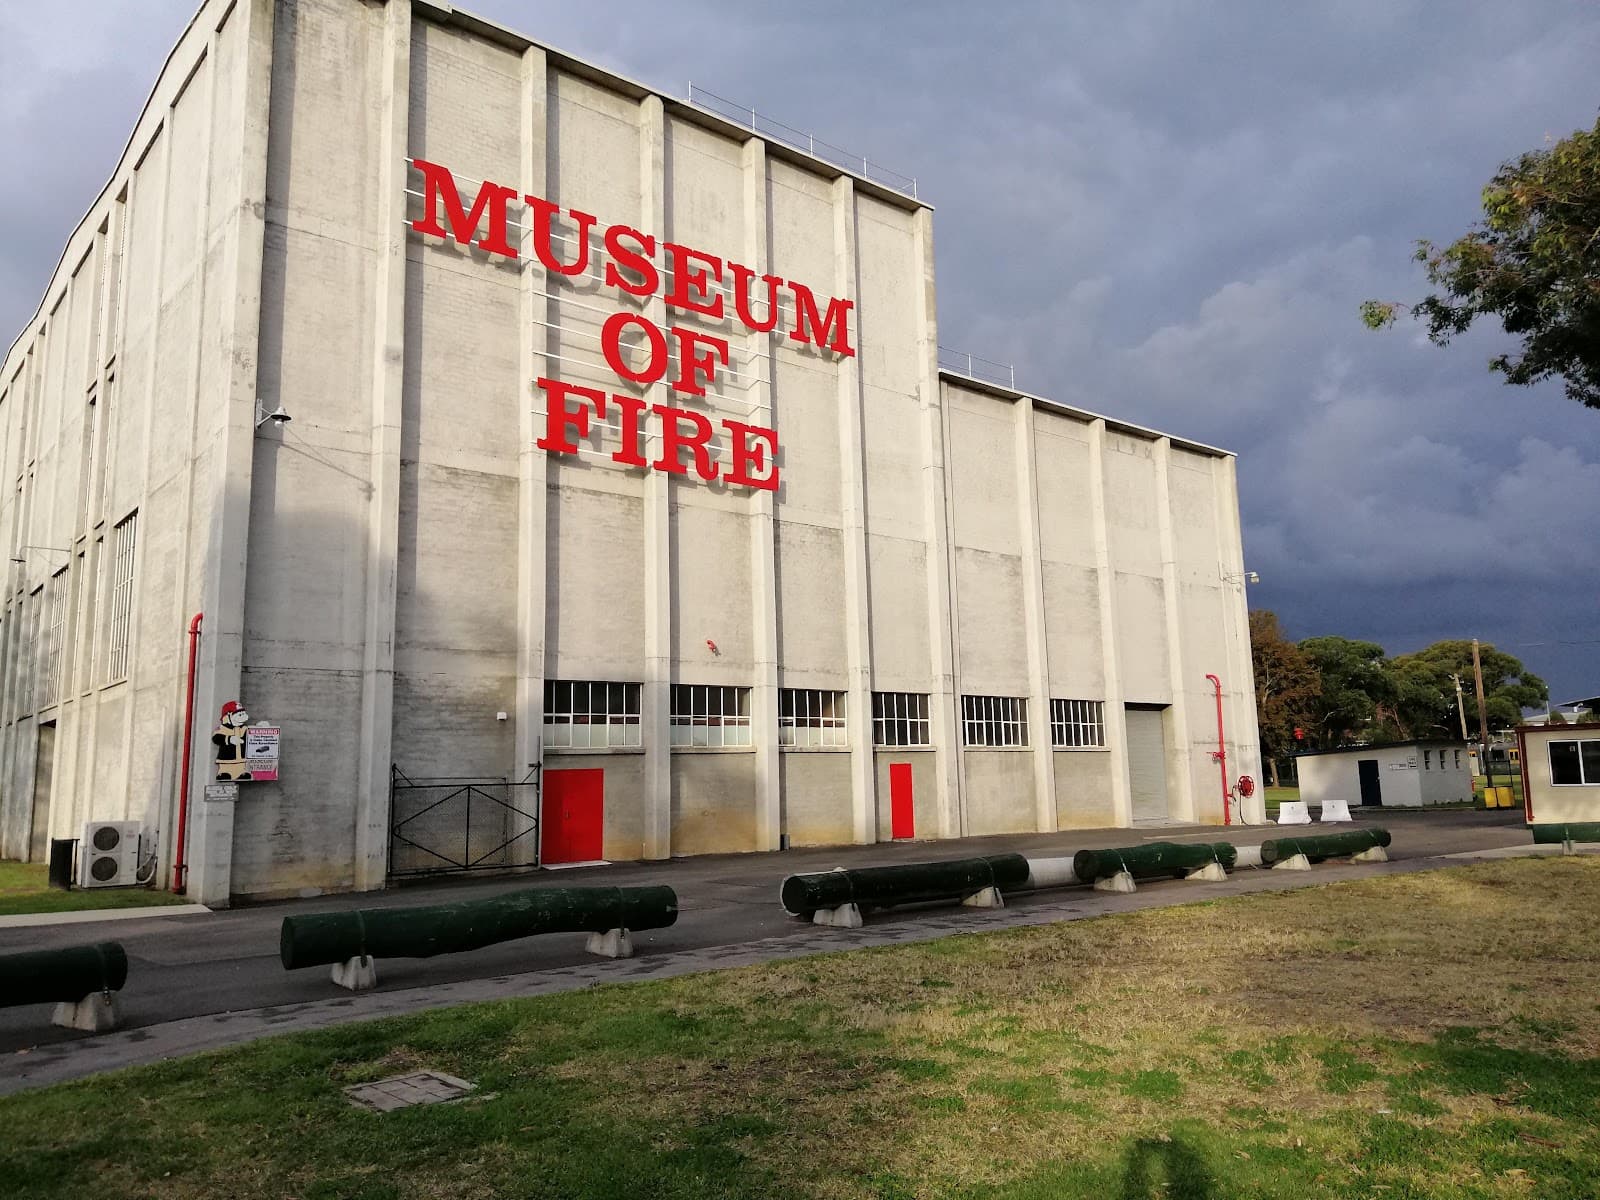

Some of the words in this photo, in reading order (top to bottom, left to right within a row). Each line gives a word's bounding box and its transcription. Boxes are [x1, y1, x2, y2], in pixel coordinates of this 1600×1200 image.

[412, 159, 855, 357] MUSEUM
[601, 312, 729, 397] OF
[536, 377, 780, 493] FIRE
